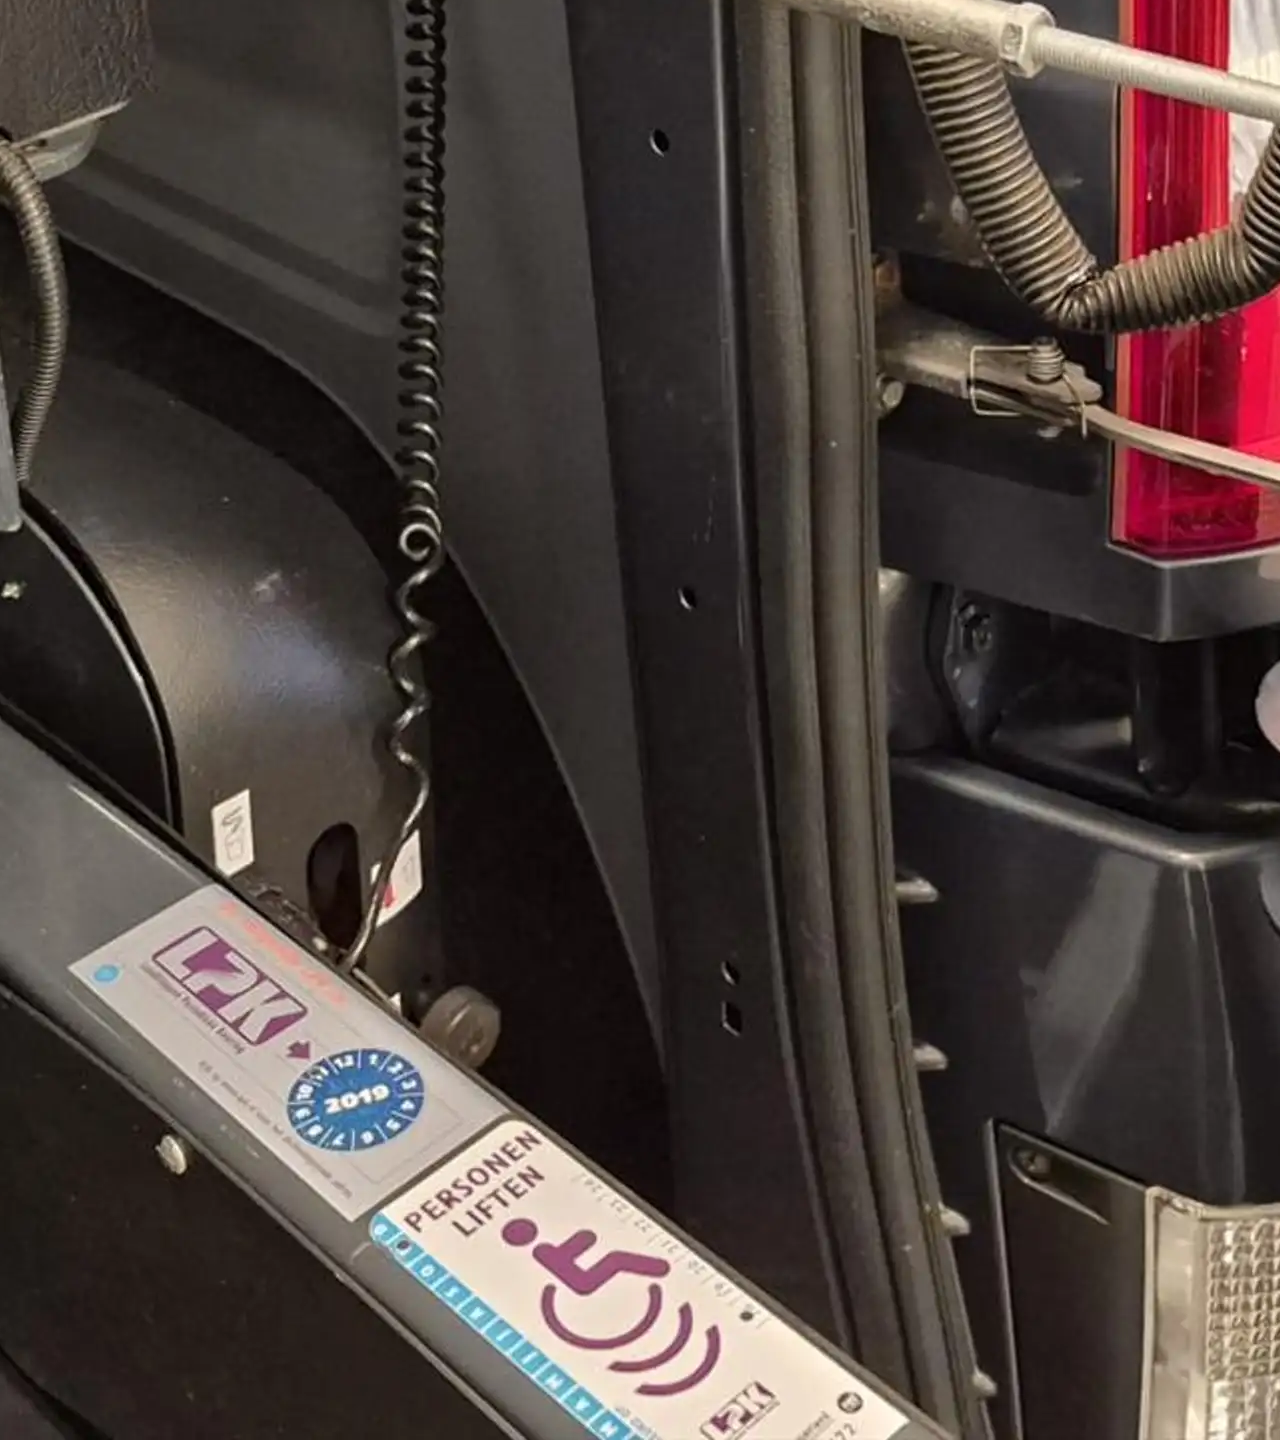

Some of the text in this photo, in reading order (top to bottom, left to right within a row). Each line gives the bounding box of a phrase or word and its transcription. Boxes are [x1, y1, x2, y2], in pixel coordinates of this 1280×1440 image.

[155, 927, 305, 1045] LPK
[296, 1084, 313, 1100] 10
[334, 1055, 354, 1068] 12
[324, 1084, 390, 1115] 2019
[404, 1130, 542, 1233] PERSONEN
[452, 1165, 545, 1237] LIFTEN
